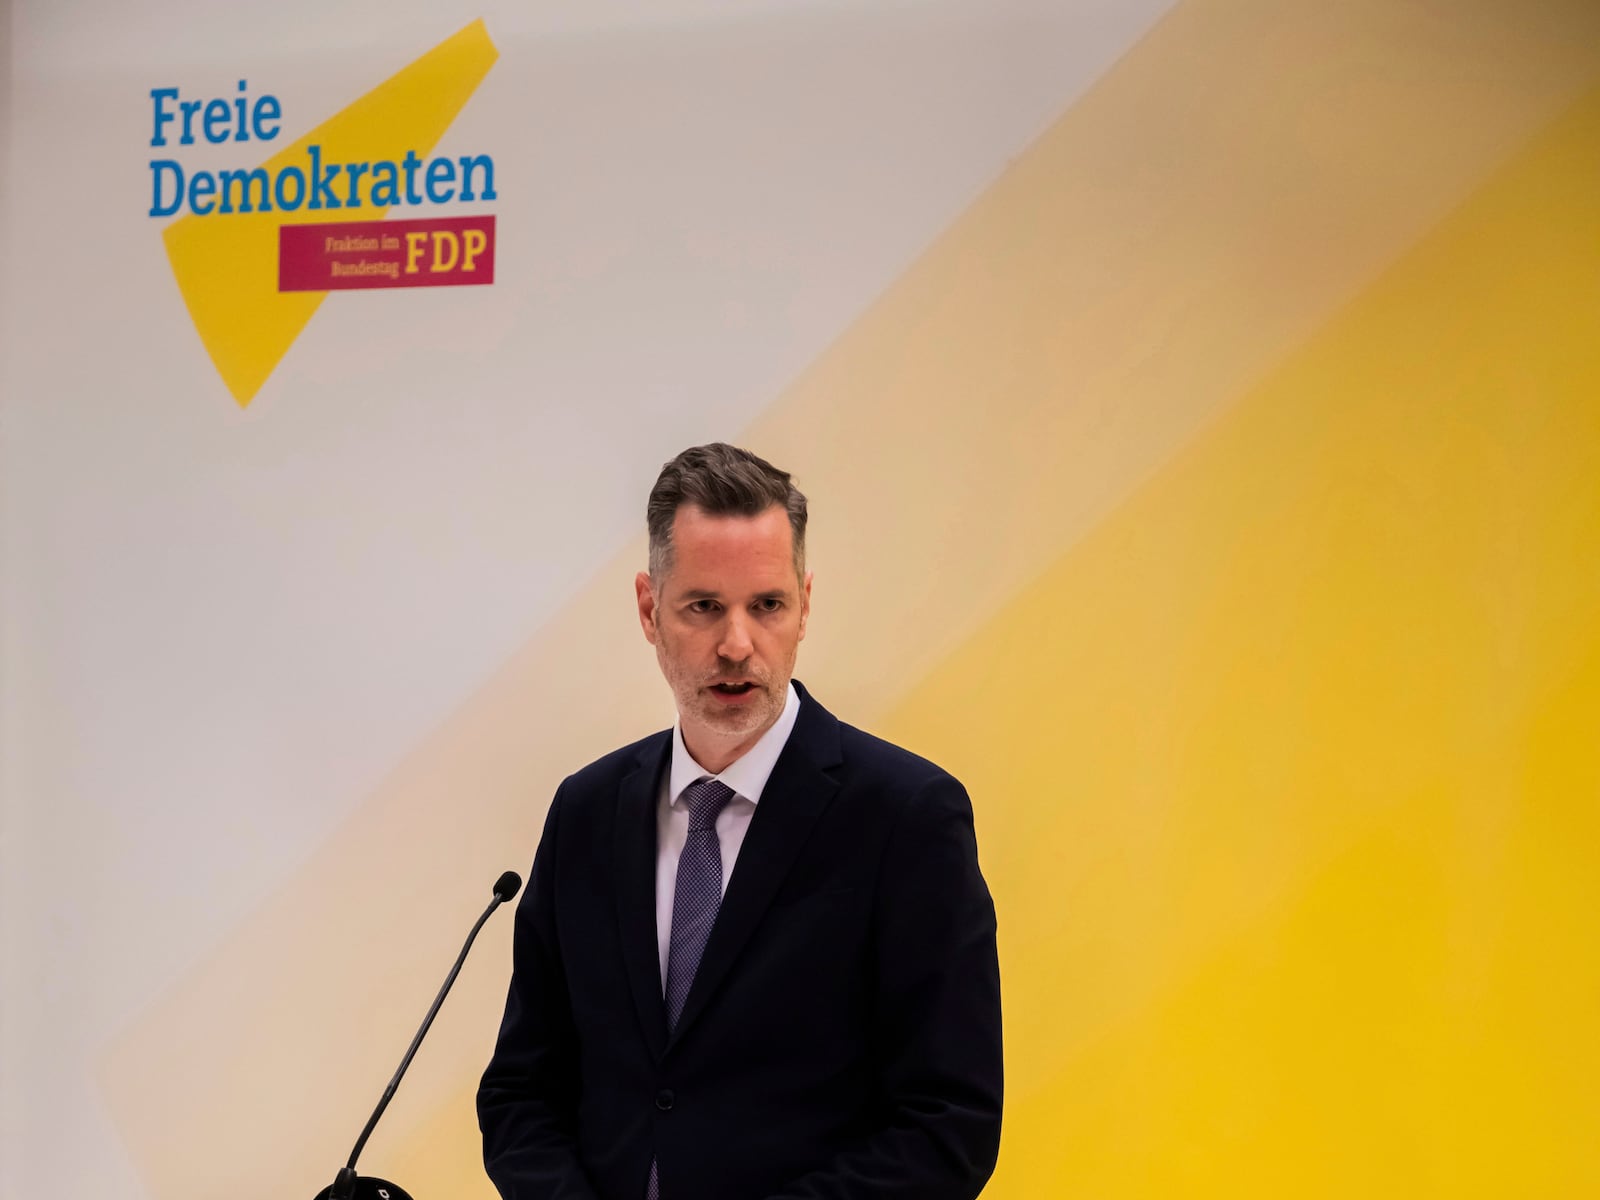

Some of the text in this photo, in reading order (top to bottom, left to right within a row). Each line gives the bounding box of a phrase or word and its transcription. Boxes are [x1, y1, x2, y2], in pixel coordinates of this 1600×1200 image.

[150, 79, 282, 147] Freie
[149, 144, 497, 218] Demokraten
[325, 233, 400, 252] Fraktion im
[405, 229, 488, 274] FDP
[331, 259, 399, 279] Bundestag
